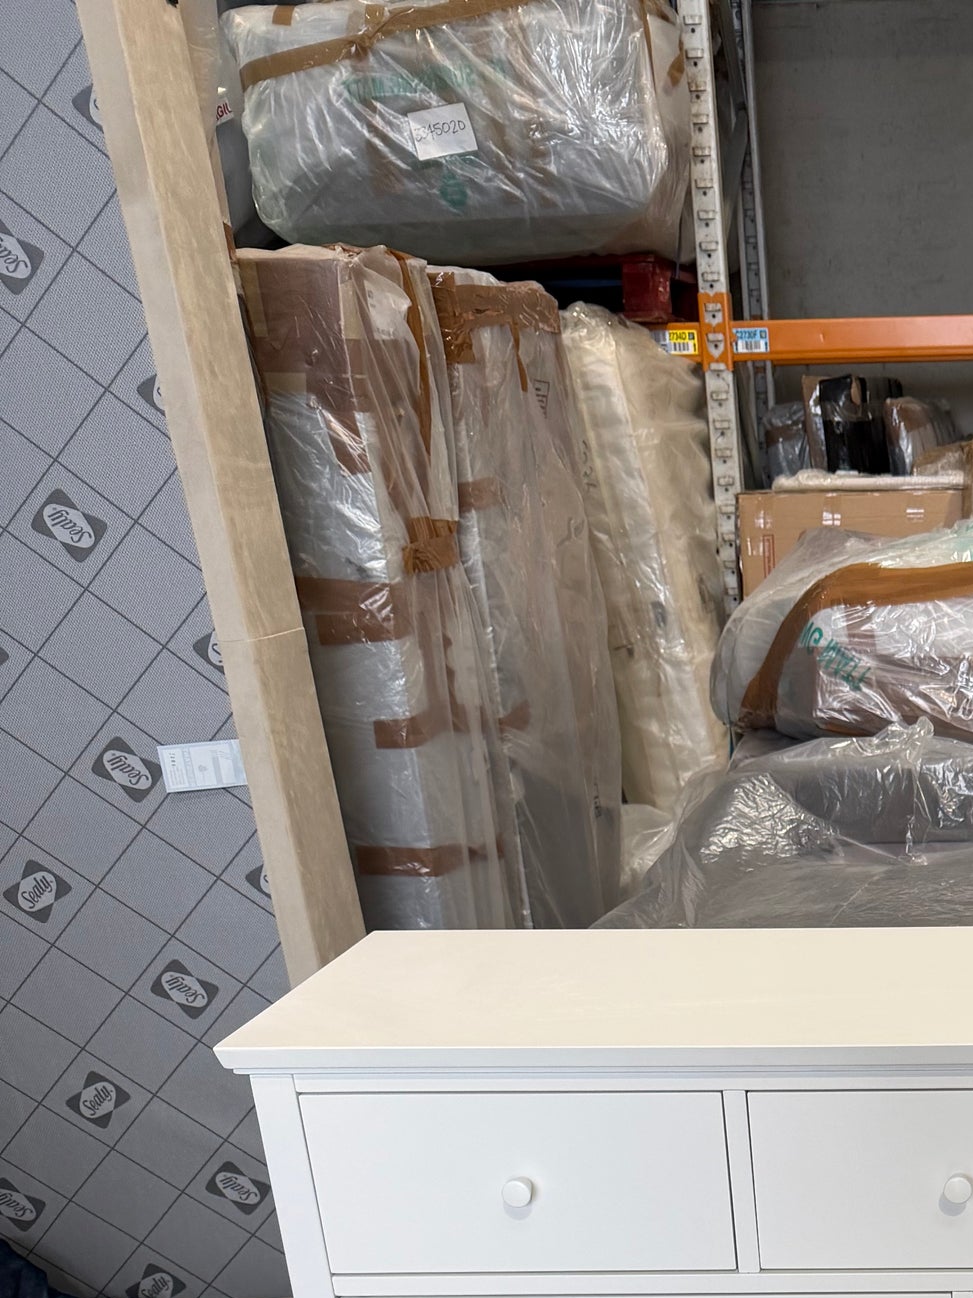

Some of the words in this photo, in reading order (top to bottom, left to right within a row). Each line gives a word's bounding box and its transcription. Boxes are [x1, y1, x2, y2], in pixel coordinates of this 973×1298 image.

[216, 102, 232, 121] GIL
[0, 237, 29, 274] Sea
[47, 508, 93, 544] Sealy
[106, 754, 150, 786] Sealy
[20, 874, 54, 910] Sealy
[164, 975, 206, 1004] Sealy
[82, 1084, 113, 1117] Sealy
[219, 1175, 258, 1201] Sealy
